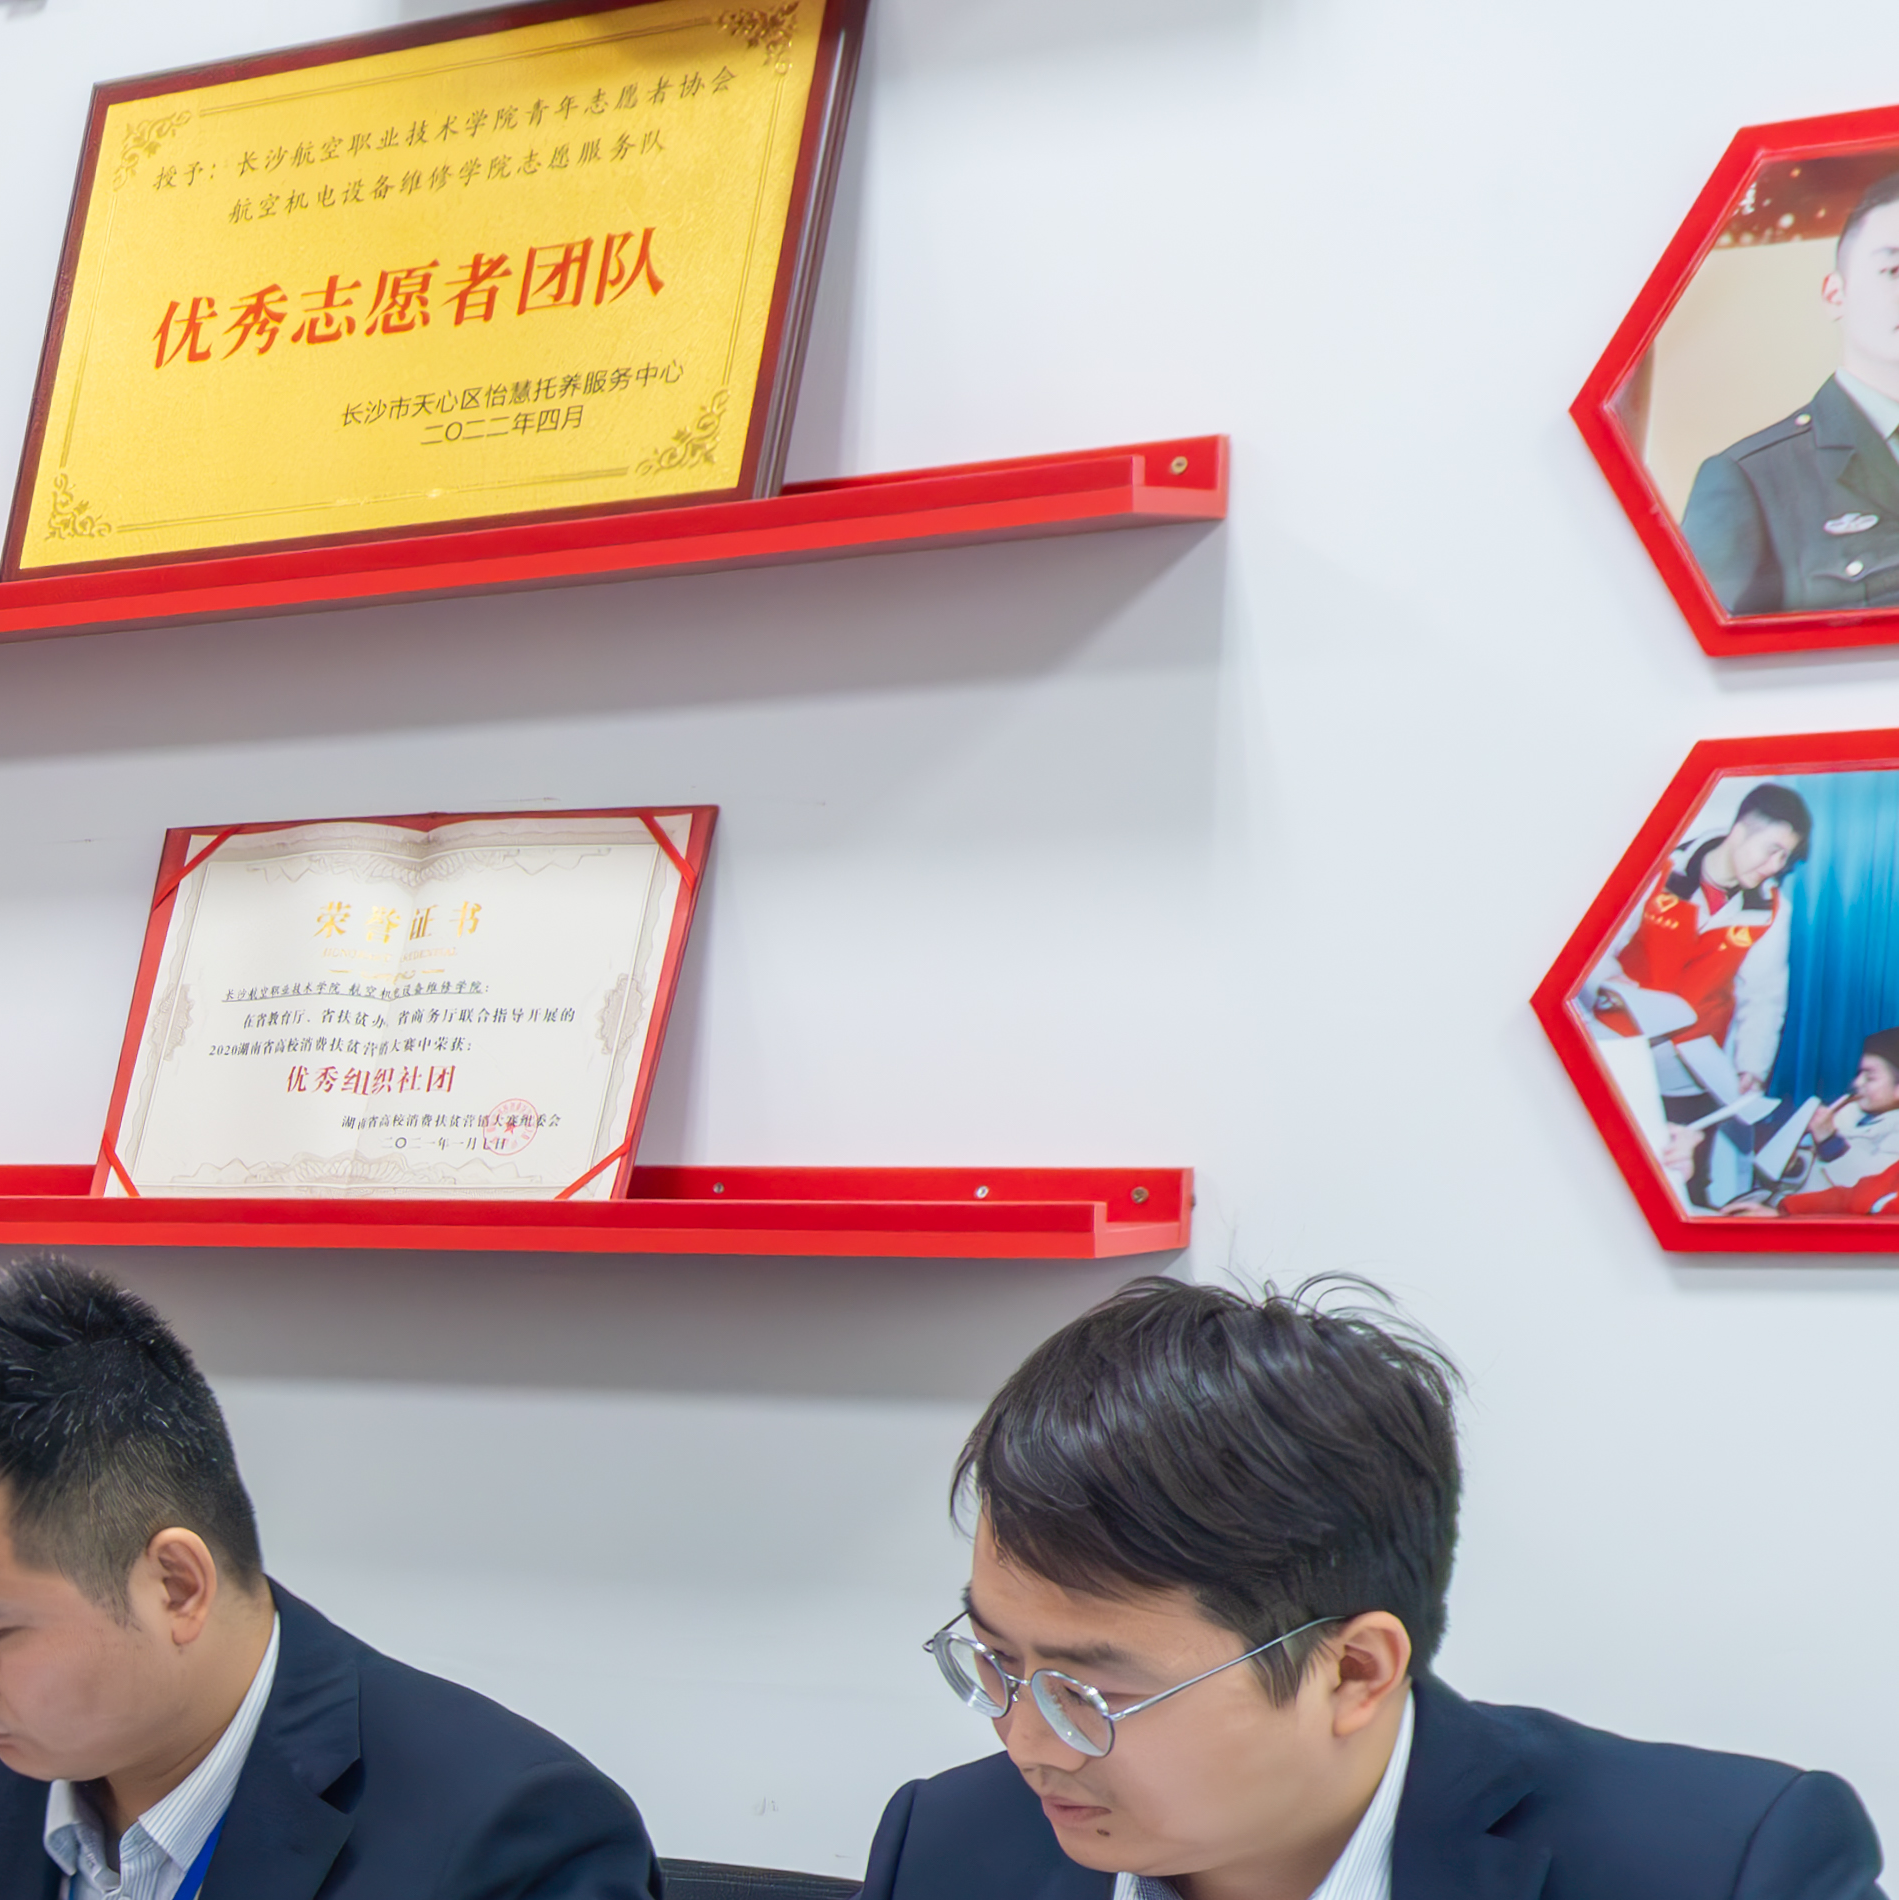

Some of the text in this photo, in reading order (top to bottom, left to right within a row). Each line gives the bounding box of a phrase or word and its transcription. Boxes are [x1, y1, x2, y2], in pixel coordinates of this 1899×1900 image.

[228, 128, 666, 226] 航空机电设备维修学院志愿服务队
[153, 226, 666, 371] 优秀志愿者团队
[341, 358, 686, 429] 长沙市天心区怡慧托养服务中心
[313, 901, 482, 943] 荣誉证书
[286, 1064, 457, 1095] 优秀组织社团
